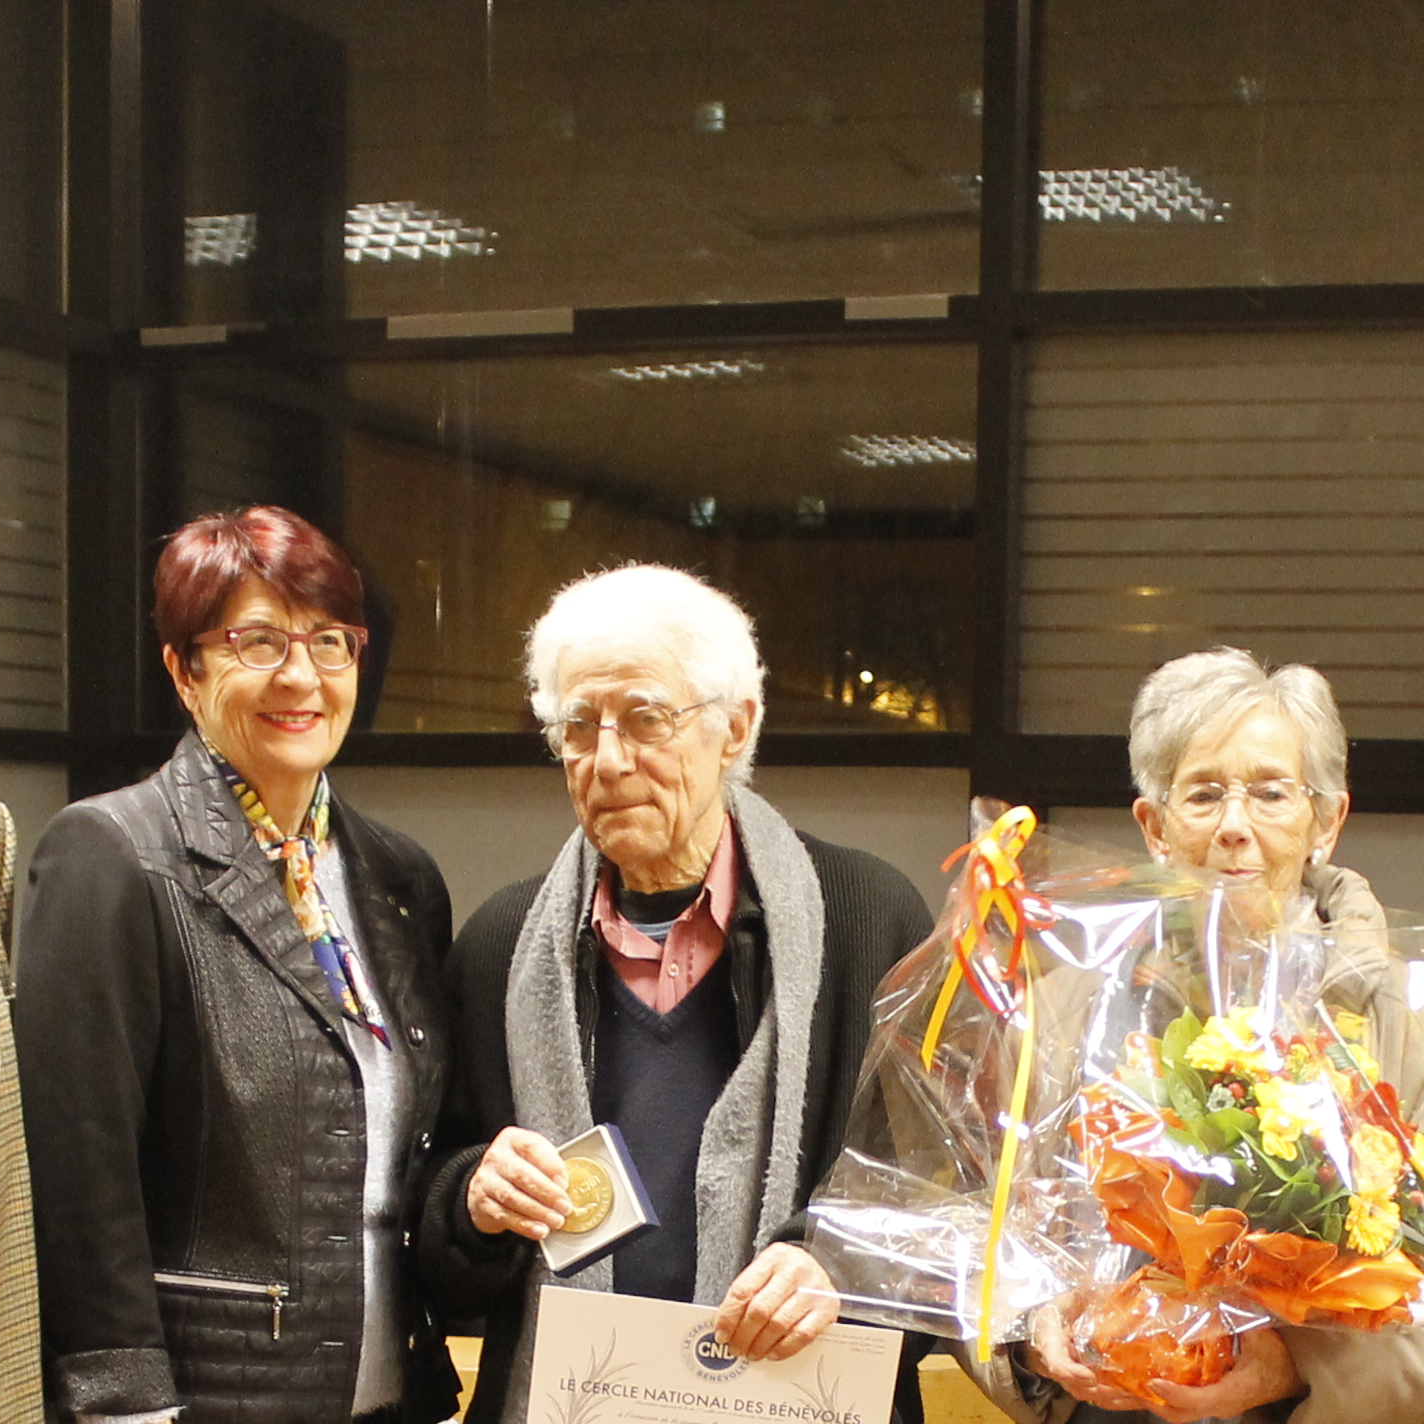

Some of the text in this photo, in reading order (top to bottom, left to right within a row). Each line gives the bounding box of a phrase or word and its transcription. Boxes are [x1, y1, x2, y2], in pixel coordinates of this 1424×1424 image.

[559, 1378, 576, 1391] LE
[581, 1380, 639, 1399] CERCLE
[643, 1388, 729, 1410] NATIONAL
[734, 1399, 764, 1415] DES
